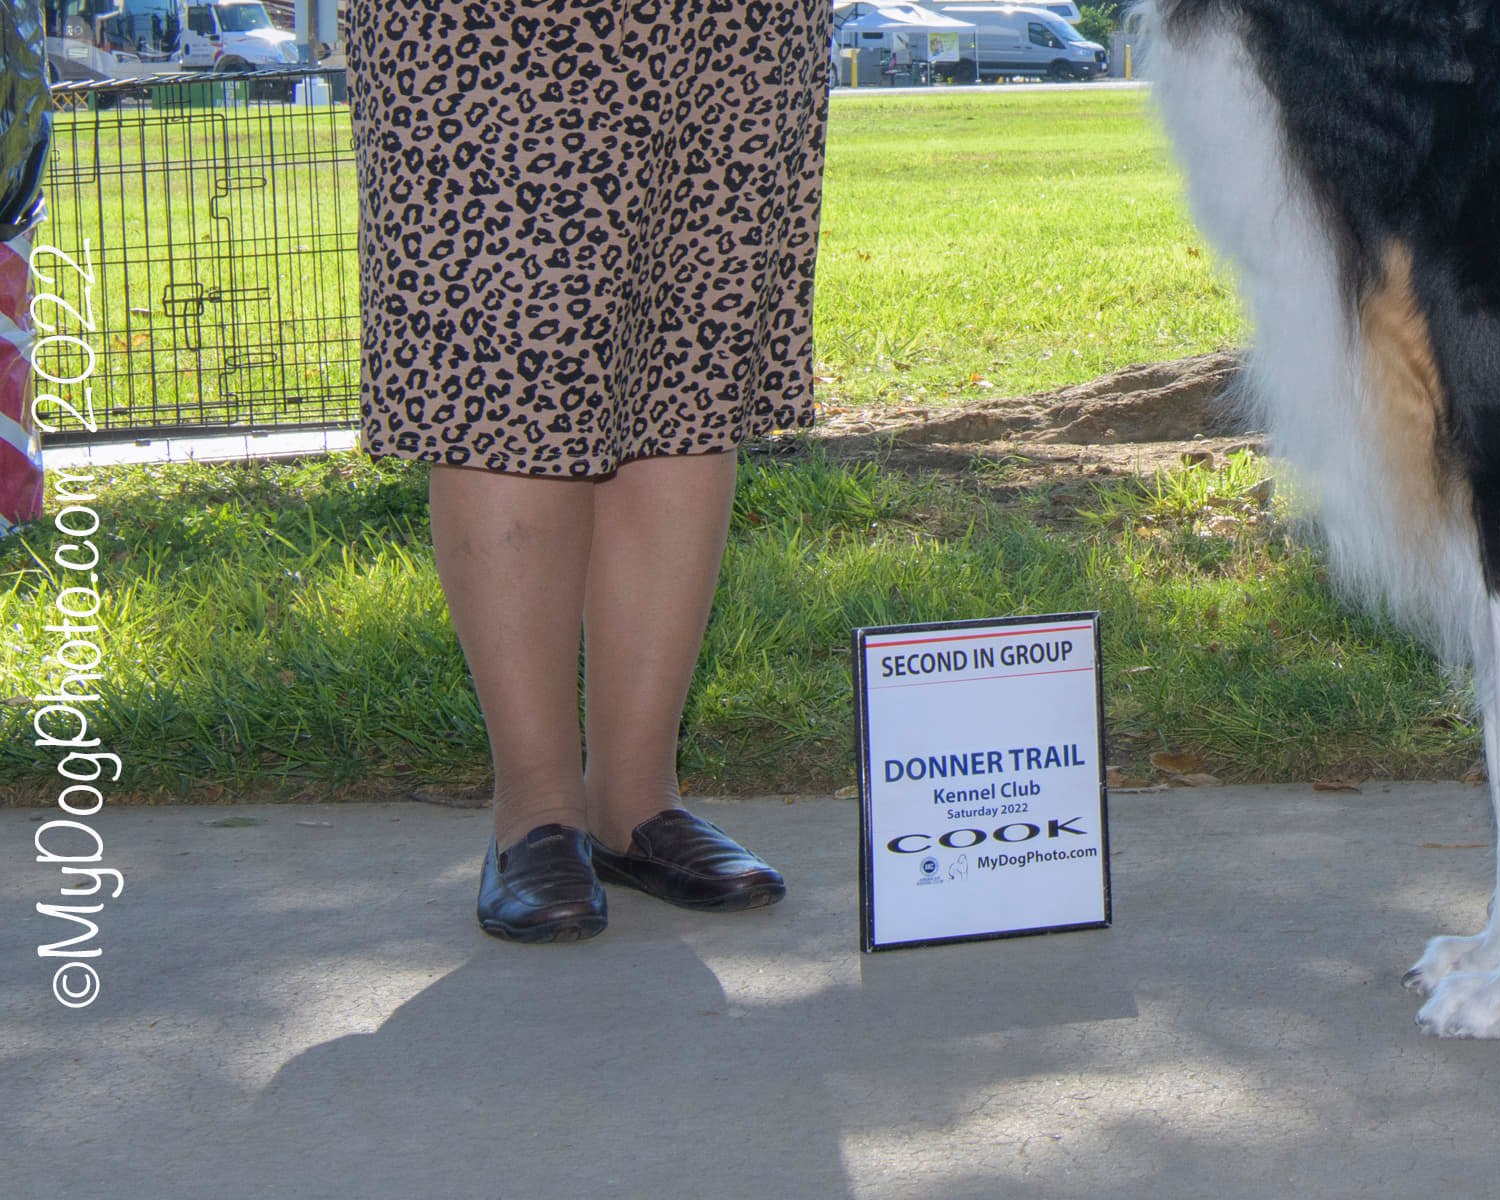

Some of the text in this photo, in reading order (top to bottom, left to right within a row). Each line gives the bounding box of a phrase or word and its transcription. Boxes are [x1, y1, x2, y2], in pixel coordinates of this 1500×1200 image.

[882, 640, 1073, 677] SECOND IN GROUP
[884, 744, 1085, 783] DONNER TRAIL
[933, 780, 1040, 804] Kennel Club
[947, 803, 1028, 819] Saturday 2022
[887, 817, 1087, 854] COOK
[977, 846, 1097, 870] MyDogPhoto.com
